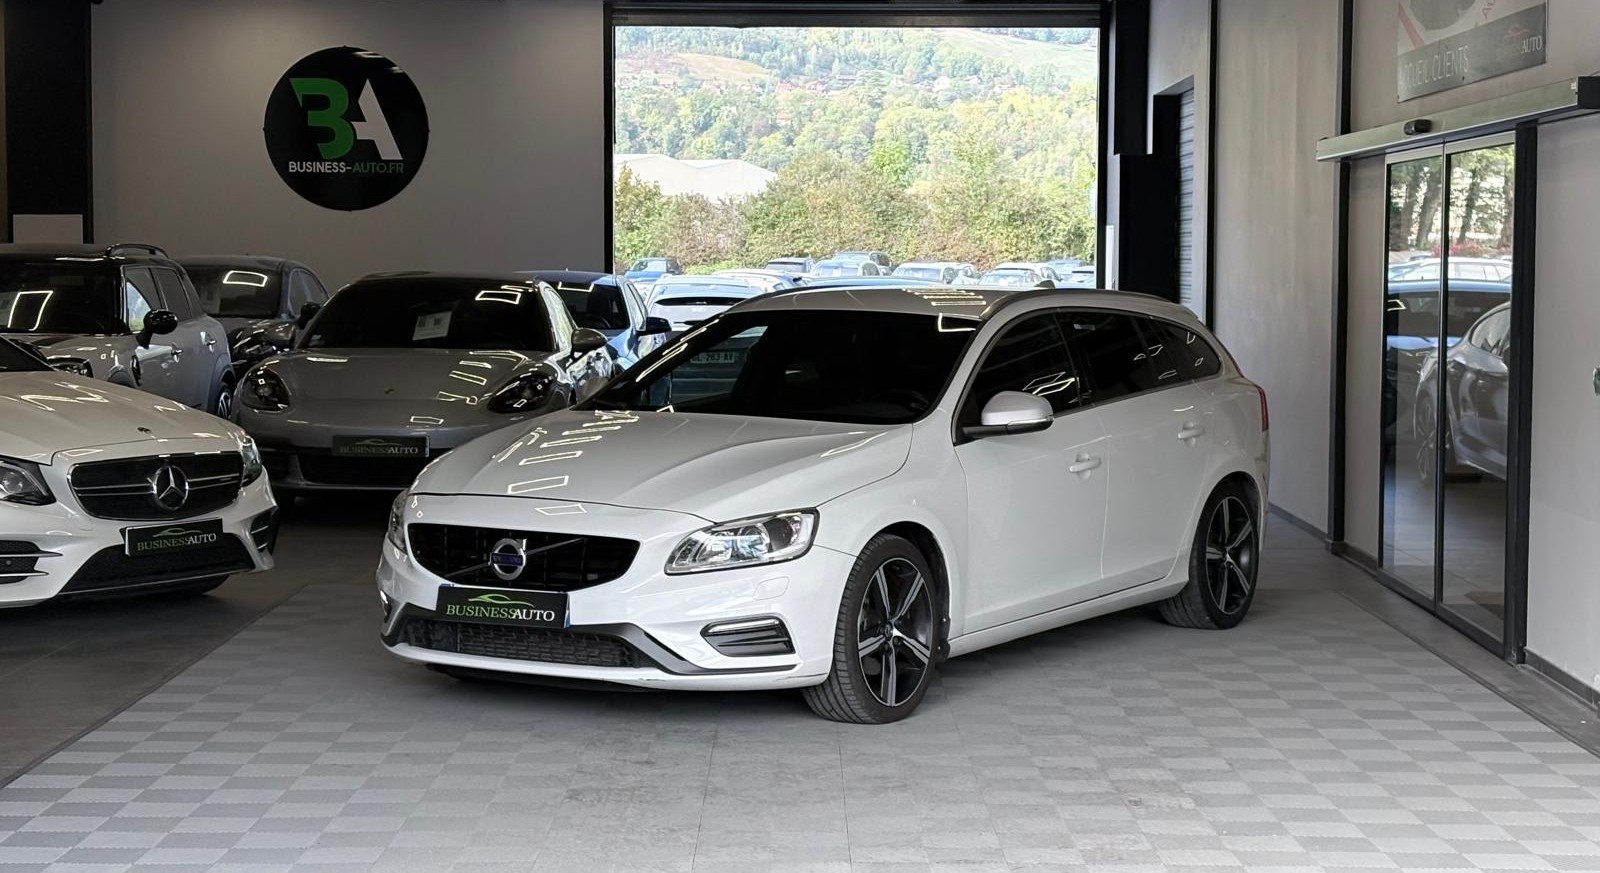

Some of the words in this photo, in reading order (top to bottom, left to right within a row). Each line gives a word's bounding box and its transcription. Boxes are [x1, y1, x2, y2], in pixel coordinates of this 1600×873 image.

[1432, 45, 1470, 82] CLIENTS
[289, 77, 403, 160] BA
[288, 161, 405, 174] BUSINESS-AUTO.FR
